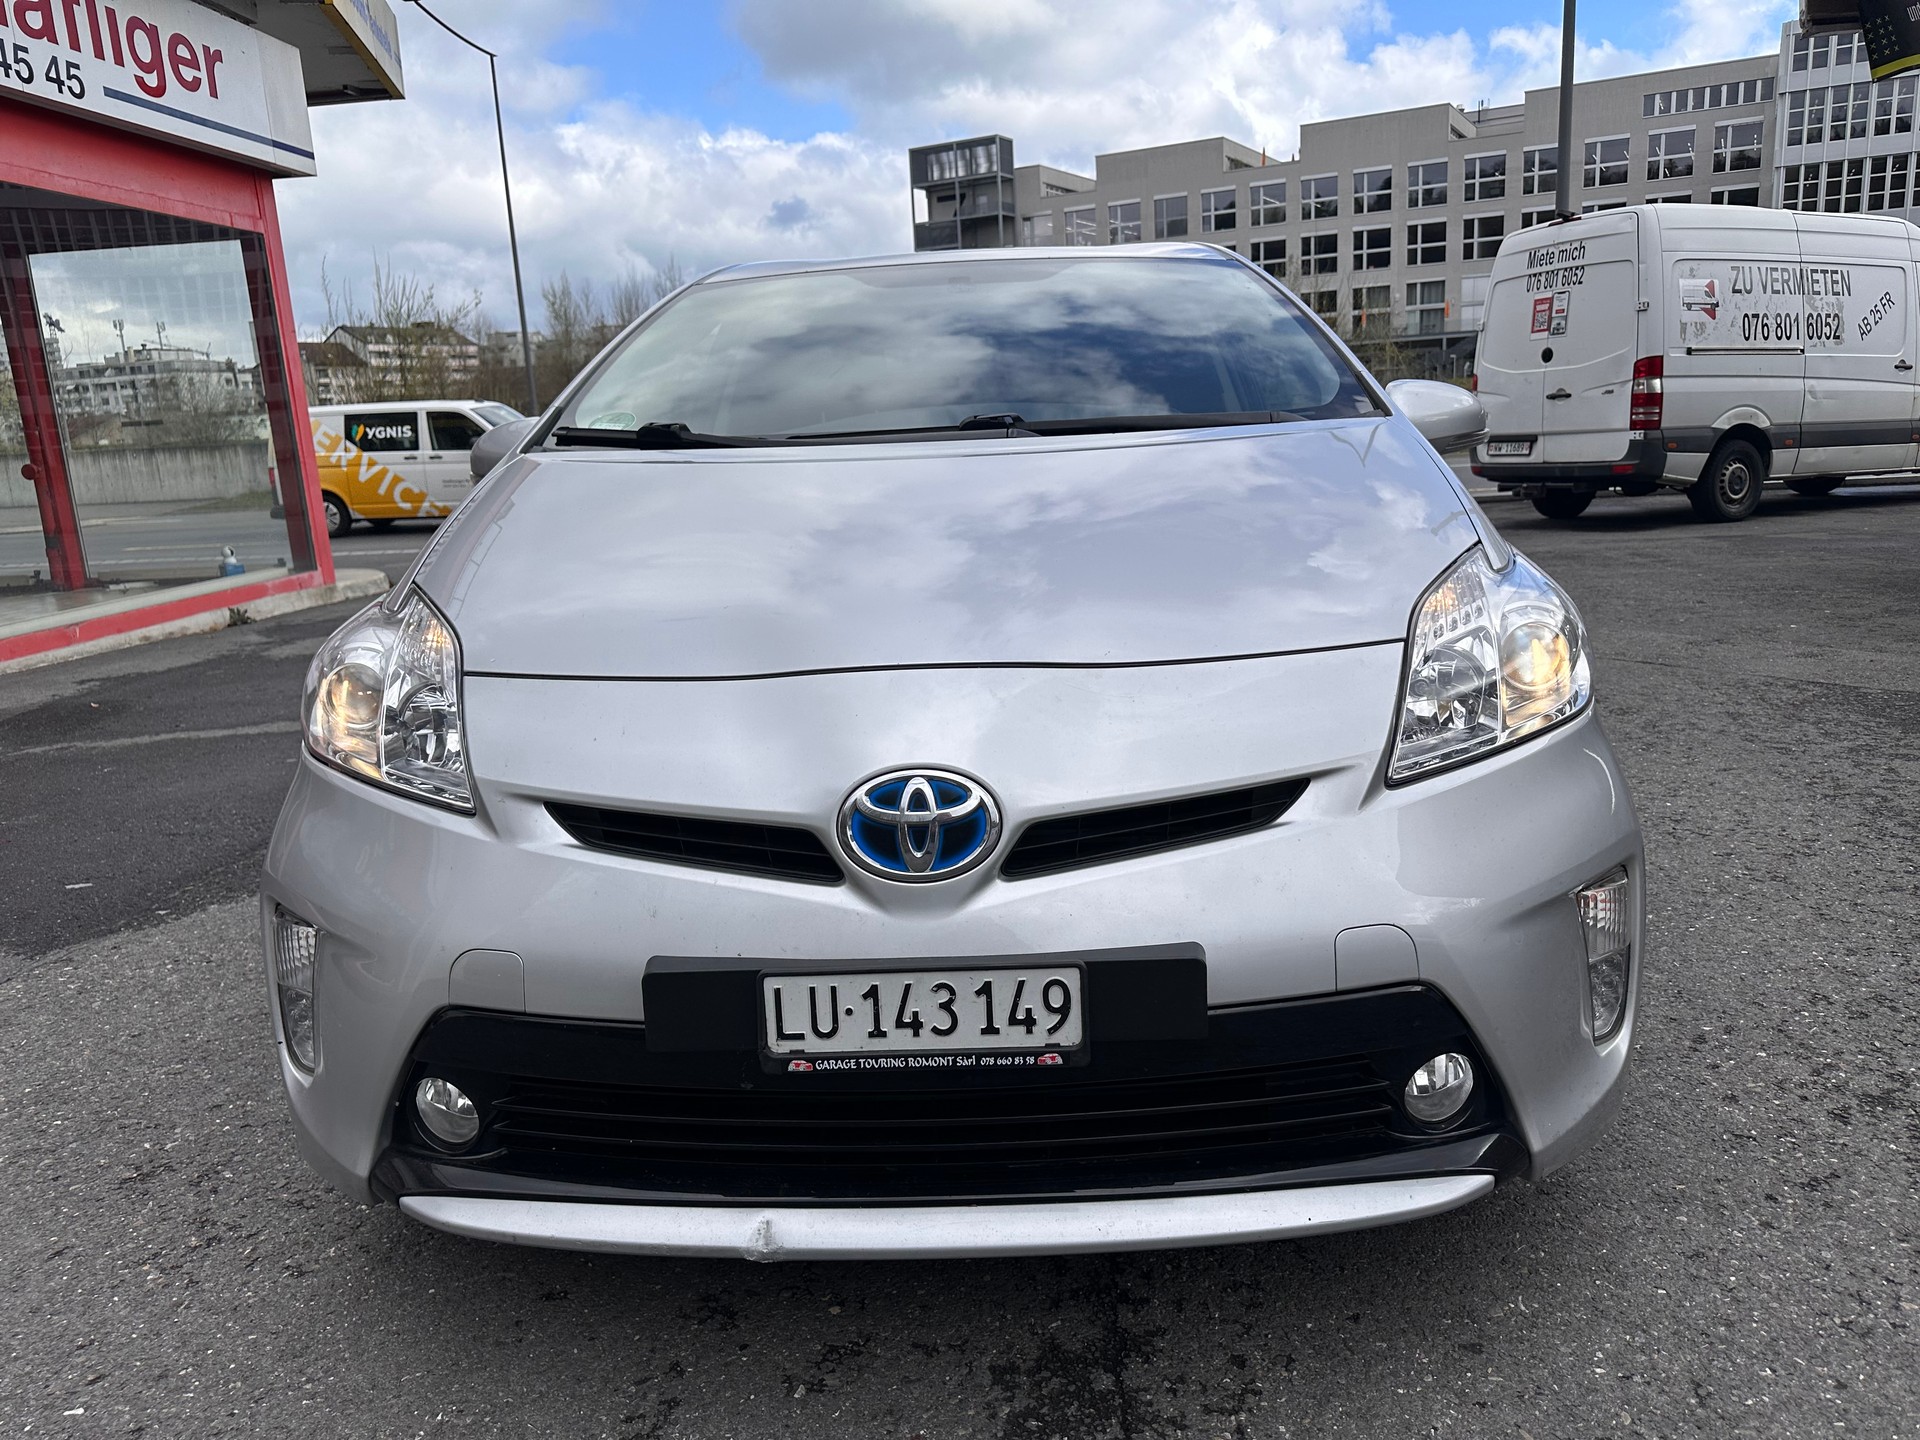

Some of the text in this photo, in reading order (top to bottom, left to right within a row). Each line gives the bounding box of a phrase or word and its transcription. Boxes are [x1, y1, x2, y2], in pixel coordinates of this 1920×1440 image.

[45, 55, 86, 100] 45
[1526, 240, 1586, 270] Miete mich
[1526, 265, 1585, 293] 076 801 6052
[1730, 265, 1852, 297] ZU VERMIETEN
[1742, 312, 1841, 341] 076 801 6052
[1856, 291, 1896, 341] AB 25 FR
[365, 425, 412, 439] YGNIS
[815, 1059, 857, 1070] GARAGE
[859, 1057, 906, 1070] TOURING
[908, 1055, 955, 1068] ROMONT
[980, 1056, 995, 1066] 078
[996, 1056, 1012, 1066] 660
[1014, 1056, 1024, 1066] 83
[1025, 1055, 1035, 1066] 58
